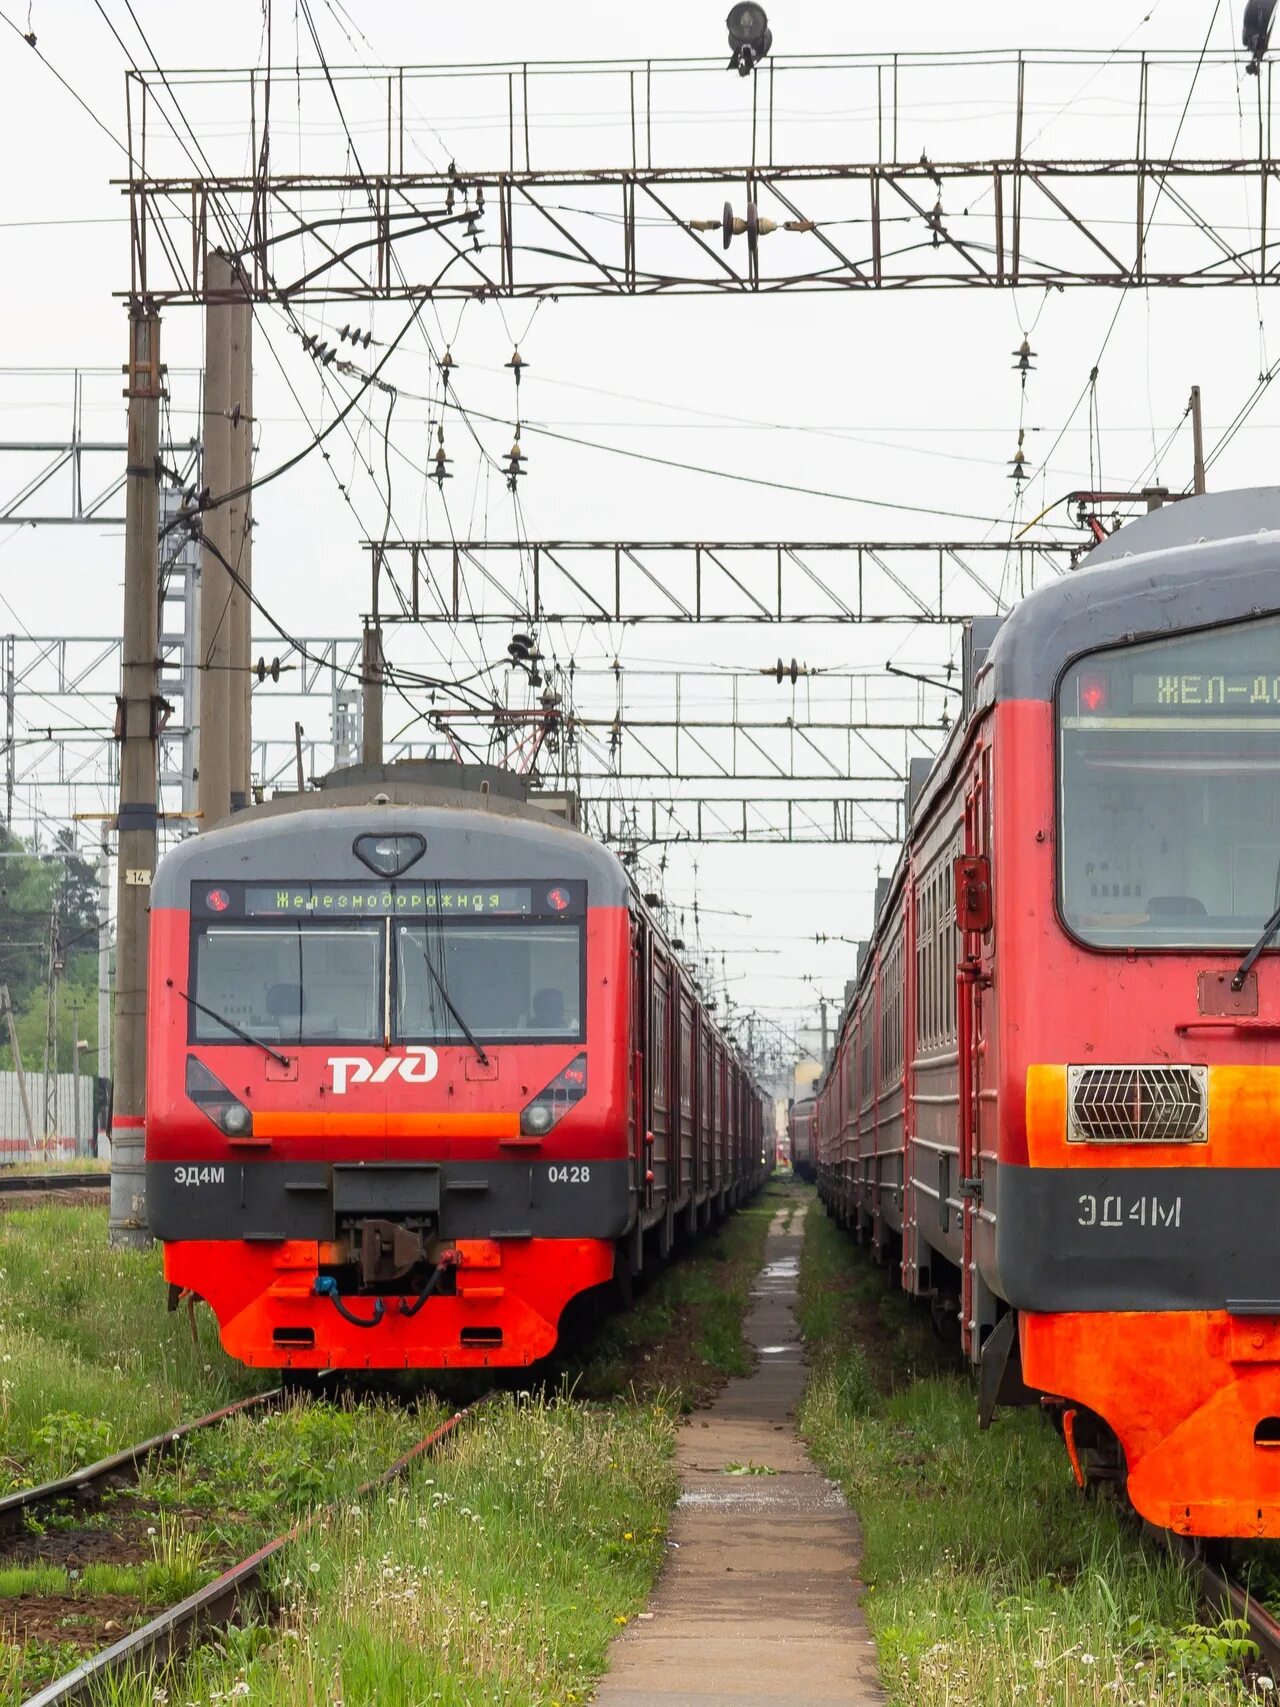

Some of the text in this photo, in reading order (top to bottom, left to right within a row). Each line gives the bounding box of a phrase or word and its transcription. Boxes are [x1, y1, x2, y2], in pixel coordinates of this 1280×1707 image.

[133, 871, 144, 883] 14
[276, 890, 499, 908] Железнодорожная
[174, 1166, 225, 1186] ЭД4М
[548, 1166, 590, 1182] 0428
[1078, 1195, 1181, 1227] ЭД4М
